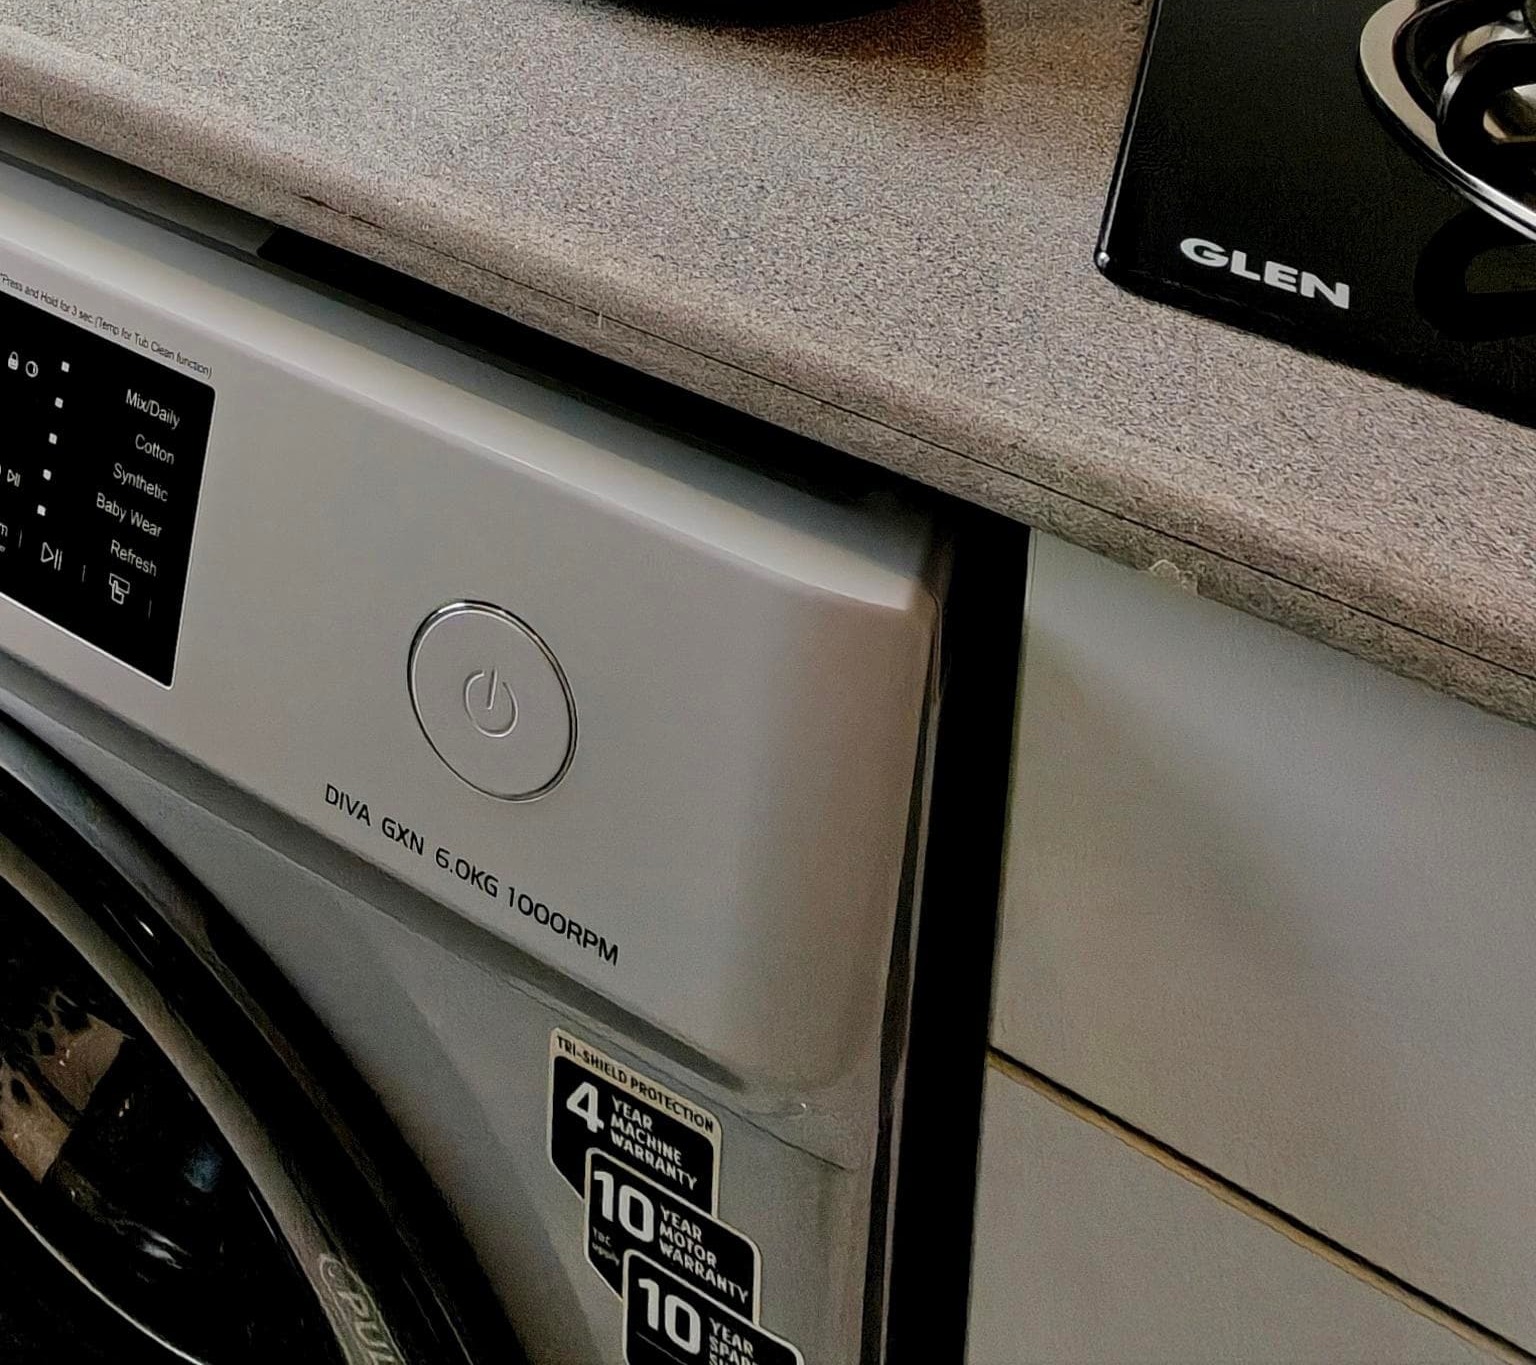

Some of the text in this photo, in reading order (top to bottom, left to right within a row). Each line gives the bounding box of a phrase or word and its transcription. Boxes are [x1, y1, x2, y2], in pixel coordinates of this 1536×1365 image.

[1180, 237, 1350, 310] GLEN
[71, 305, 78, 316] 3
[134, 332, 149, 348] Tub
[125, 388, 180, 430] Mix/Daily
[135, 433, 175, 465] Cotton
[112, 462, 168, 502] Synthetic
[96, 492, 163, 538] Baby Wear
[110, 539, 157, 577] Refresh
[325, 783, 619, 966] DIVA GXN 6.0KG 1000RPM
[557, 1035, 714, 1133] TRI-SHIELD PROTECTION
[566, 1081, 604, 1133] 4
[611, 1094, 653, 1131] YEAR
[610, 1112, 682, 1167] MACHINE
[610, 1128, 698, 1191] WARRANTY
[593, 1170, 655, 1243] 10
[660, 1202, 703, 1243] YEAR
[659, 1220, 717, 1268] MOTOR
[658, 1237, 749, 1304] WARRANTY
[637, 1277, 702, 1355] 10
[709, 1317, 754, 1358] YEAR
